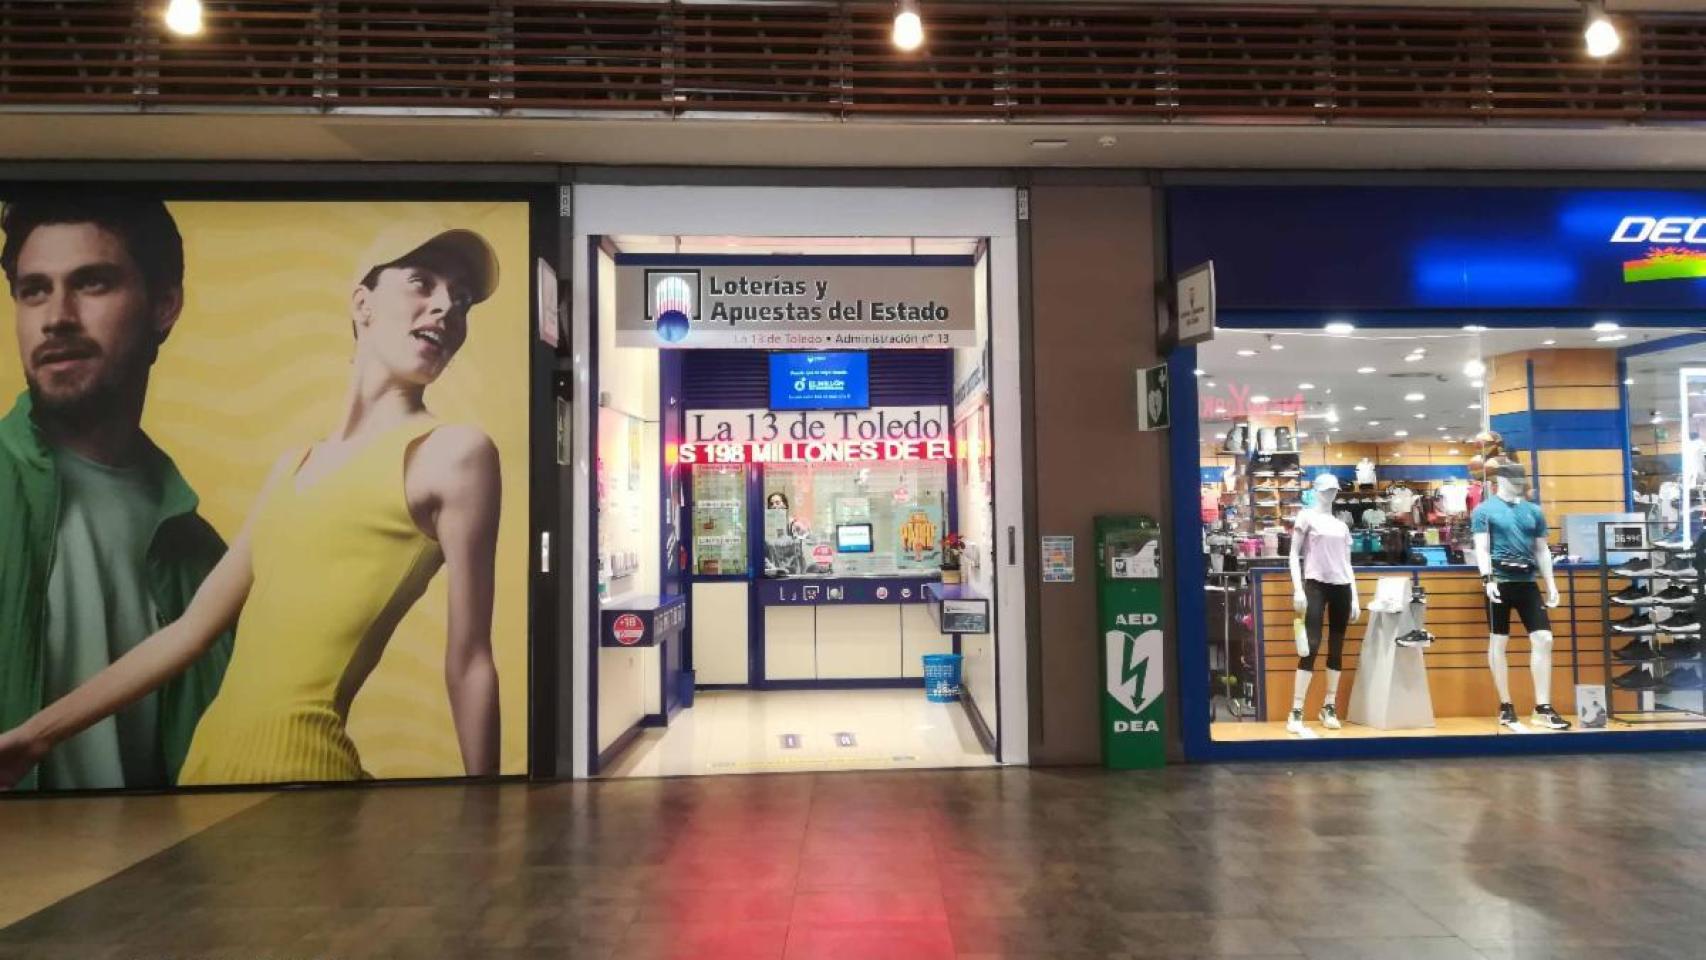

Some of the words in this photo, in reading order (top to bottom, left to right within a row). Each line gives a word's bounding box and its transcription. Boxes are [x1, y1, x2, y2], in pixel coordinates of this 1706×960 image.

[709, 274, 807, 295] Loterías
[815, 279, 828, 300] y
[710, 301, 822, 326] Apuestas
[828, 300, 863, 321] del
[870, 300, 950, 321] Estado
[768, 332, 782, 344] de
[785, 332, 822, 344] Toledo
[835, 332, 918, 344] Administración
[938, 333, 950, 344] 13
[693, 415, 733, 442] La
[747, 413, 779, 442] 13
[790, 411, 825, 441] de
[834, 410, 942, 441] Toledo
[704, 443, 745, 463] 198
[751, 441, 879, 463] MILLONES
[885, 440, 920, 460] DE
[1115, 613, 1158, 625] AED
[1113, 720, 1160, 732] DEA
